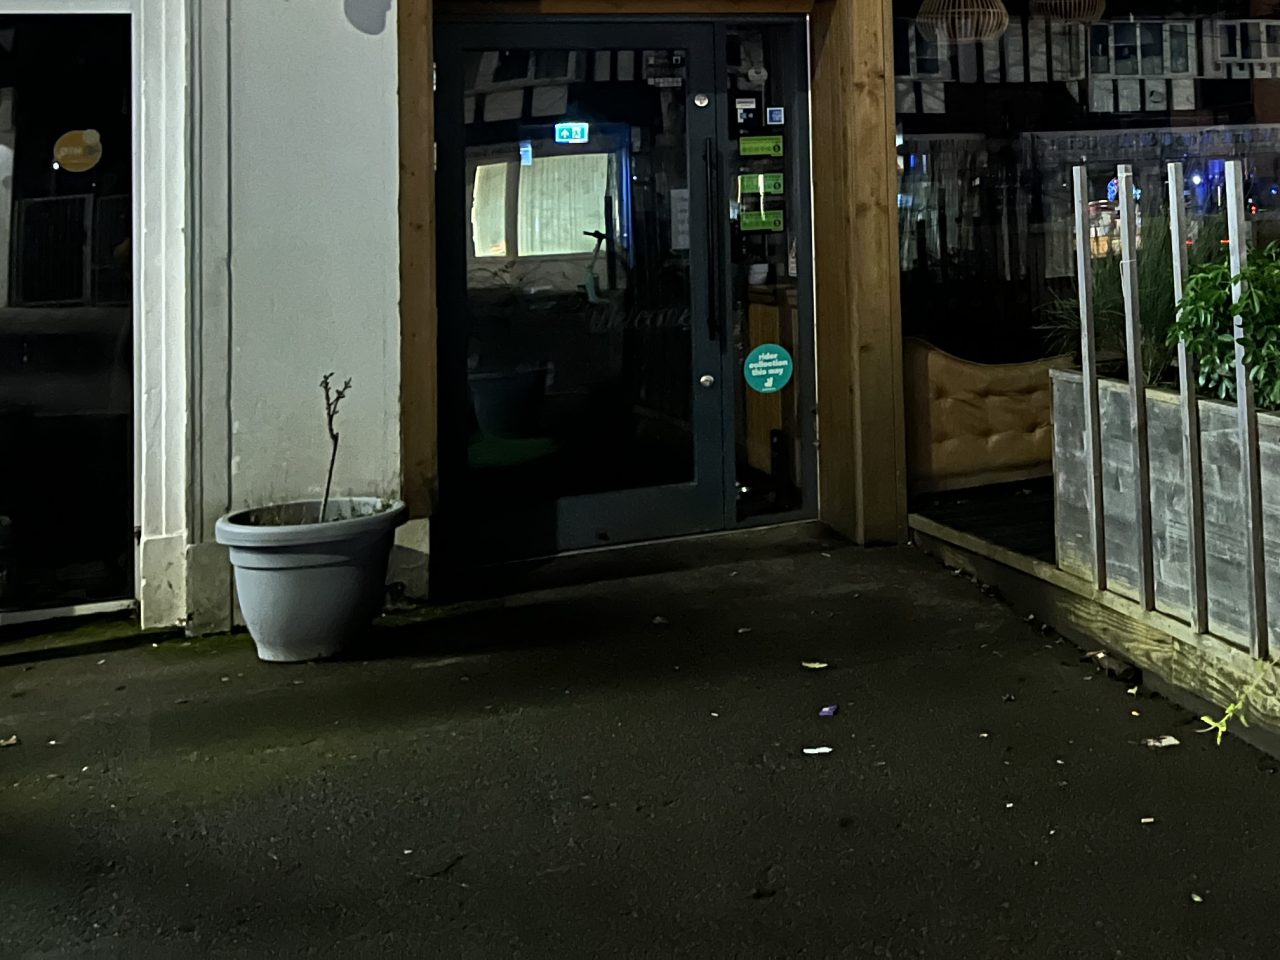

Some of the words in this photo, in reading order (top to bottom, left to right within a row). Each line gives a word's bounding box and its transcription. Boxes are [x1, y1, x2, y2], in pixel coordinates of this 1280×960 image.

[758, 352, 778, 360] rider
[749, 359, 788, 368] collection
[751, 368, 767, 376] this
[768, 367, 784, 376] way
